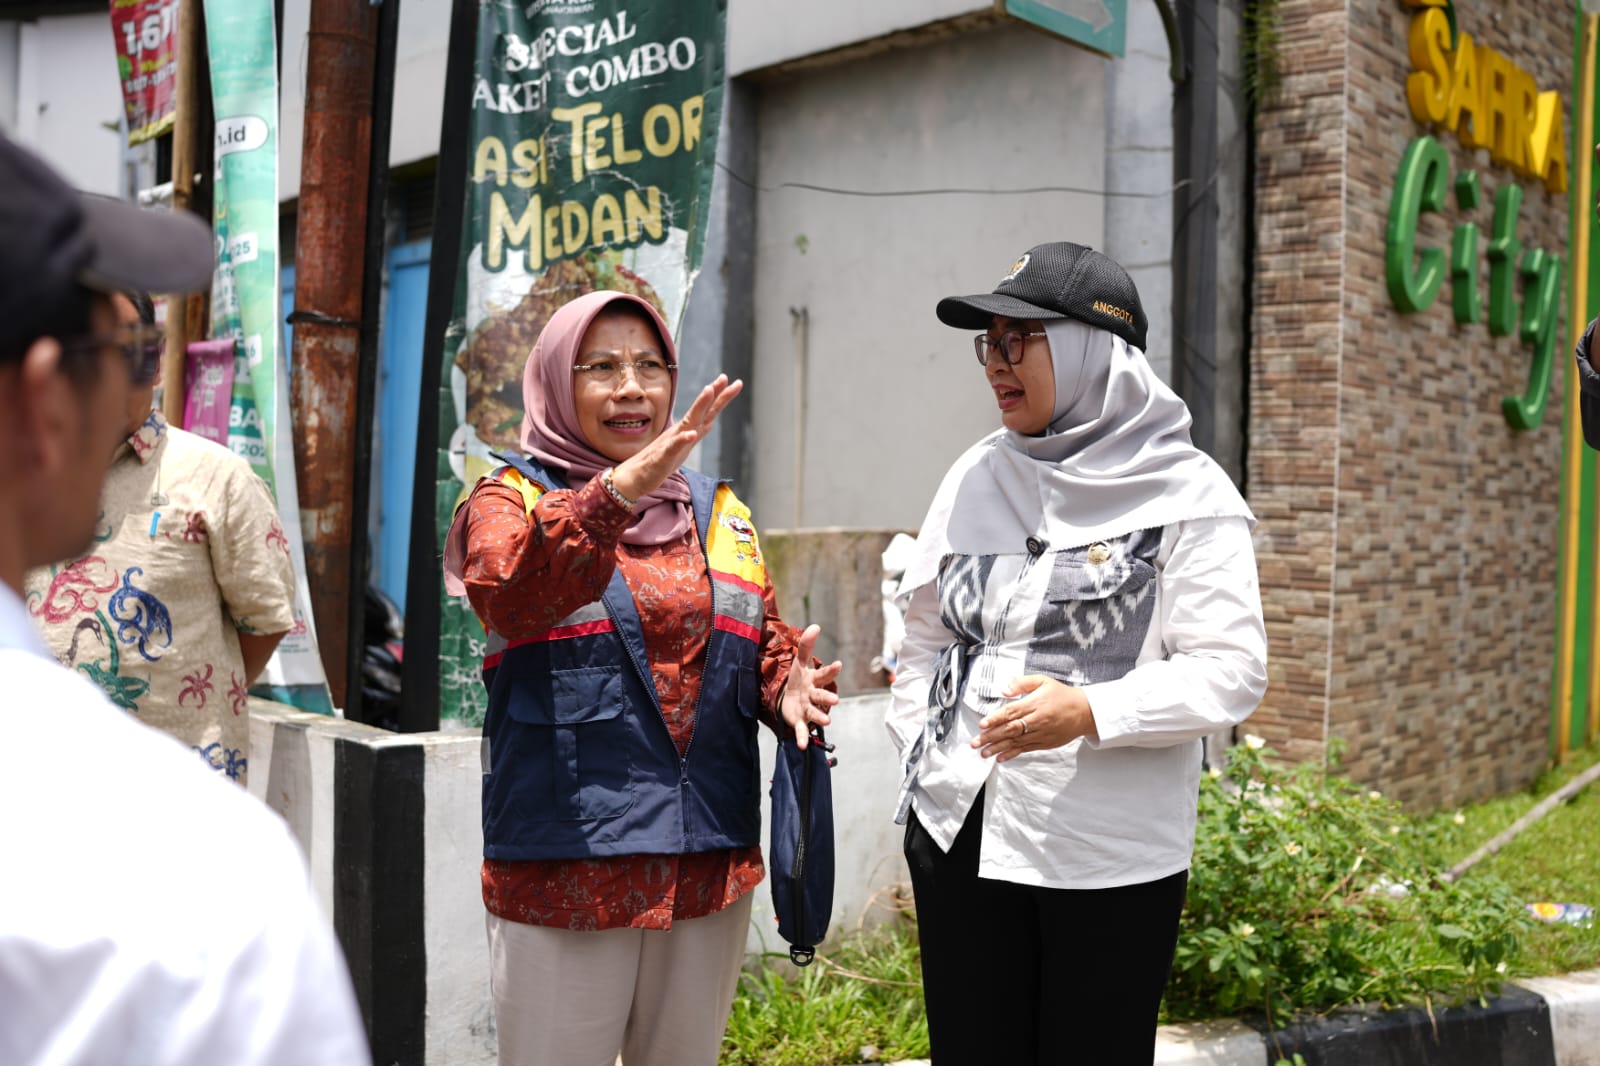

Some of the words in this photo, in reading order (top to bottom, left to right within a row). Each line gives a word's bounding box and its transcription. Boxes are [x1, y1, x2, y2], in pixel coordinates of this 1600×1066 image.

[472, 74, 551, 114] AKET
[565, 37, 696, 97] COMBO
[506, 11, 636, 72] SPECIAL
[474, 135, 548, 188] ASI
[551, 95, 704, 183] TELOR
[487, 186, 663, 271] MEDAN
[1092, 300, 1134, 325] ANGGOTA
[1386, 135, 1561, 430] City
